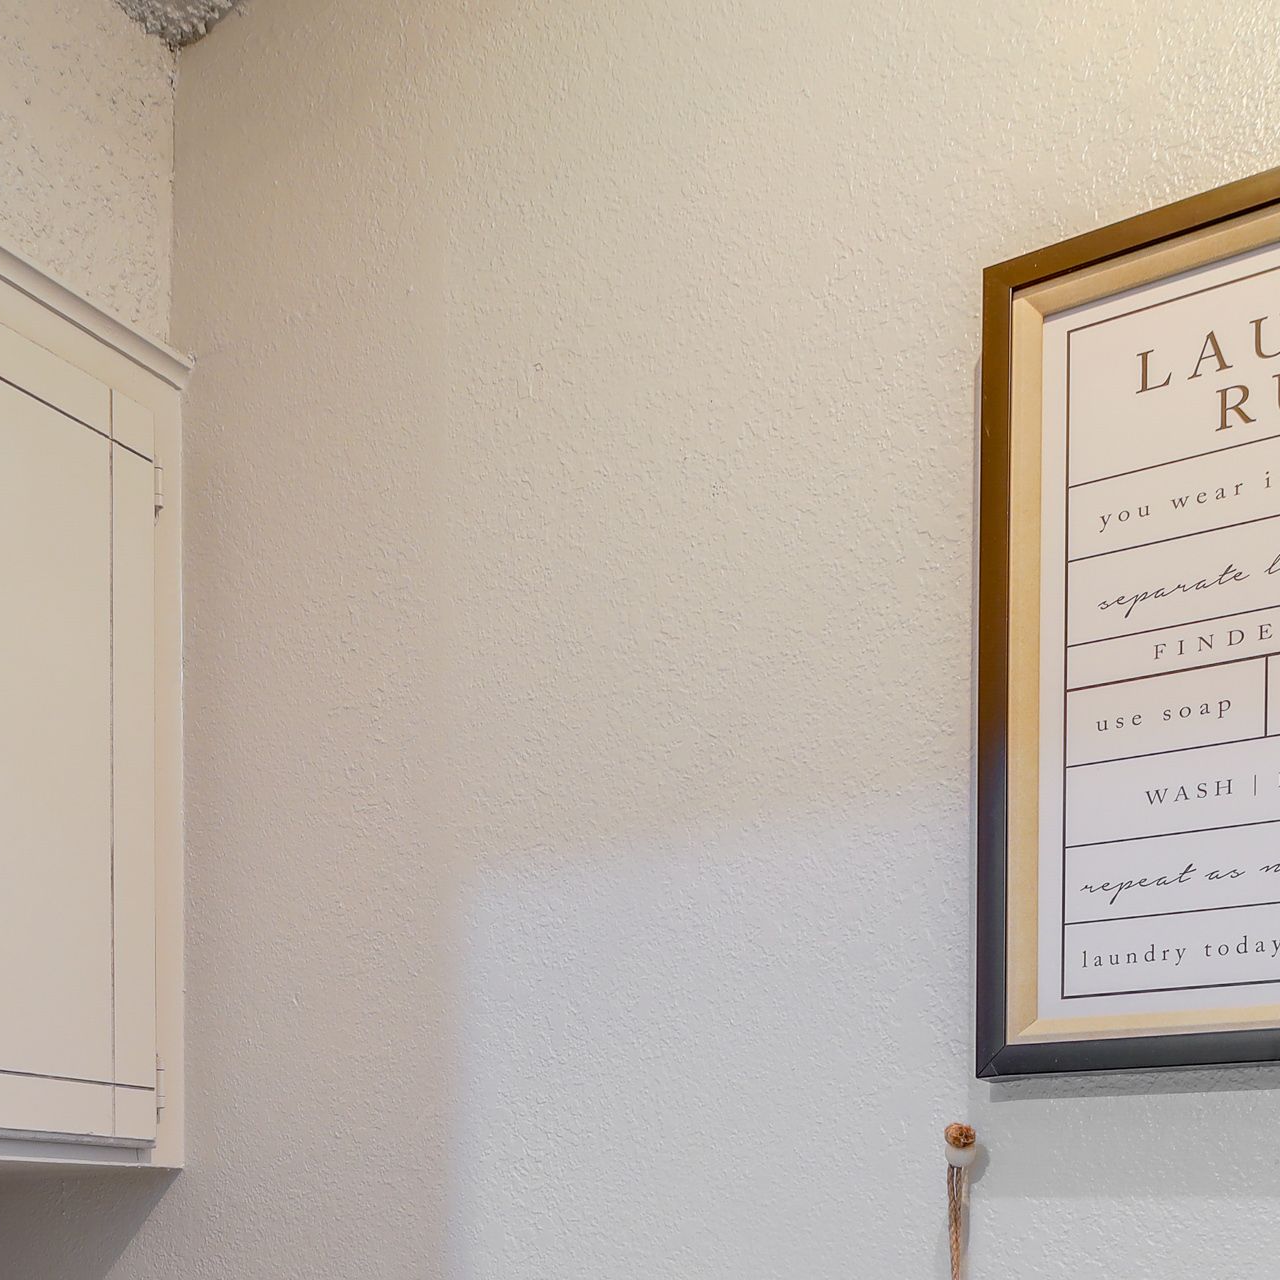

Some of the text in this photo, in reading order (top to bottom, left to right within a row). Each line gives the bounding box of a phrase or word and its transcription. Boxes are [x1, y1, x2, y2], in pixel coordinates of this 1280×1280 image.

[1099, 504, 1151, 534] you
[1169, 482, 1244, 510] wear
[1097, 563, 1251, 619] separate
[1095, 699, 1232, 732] use soap
[1144, 778, 1233, 806] WASH
[1079, 862, 1198, 906] repeat
[1204, 868, 1246, 881] as
[1081, 943, 1187, 969] laundry
